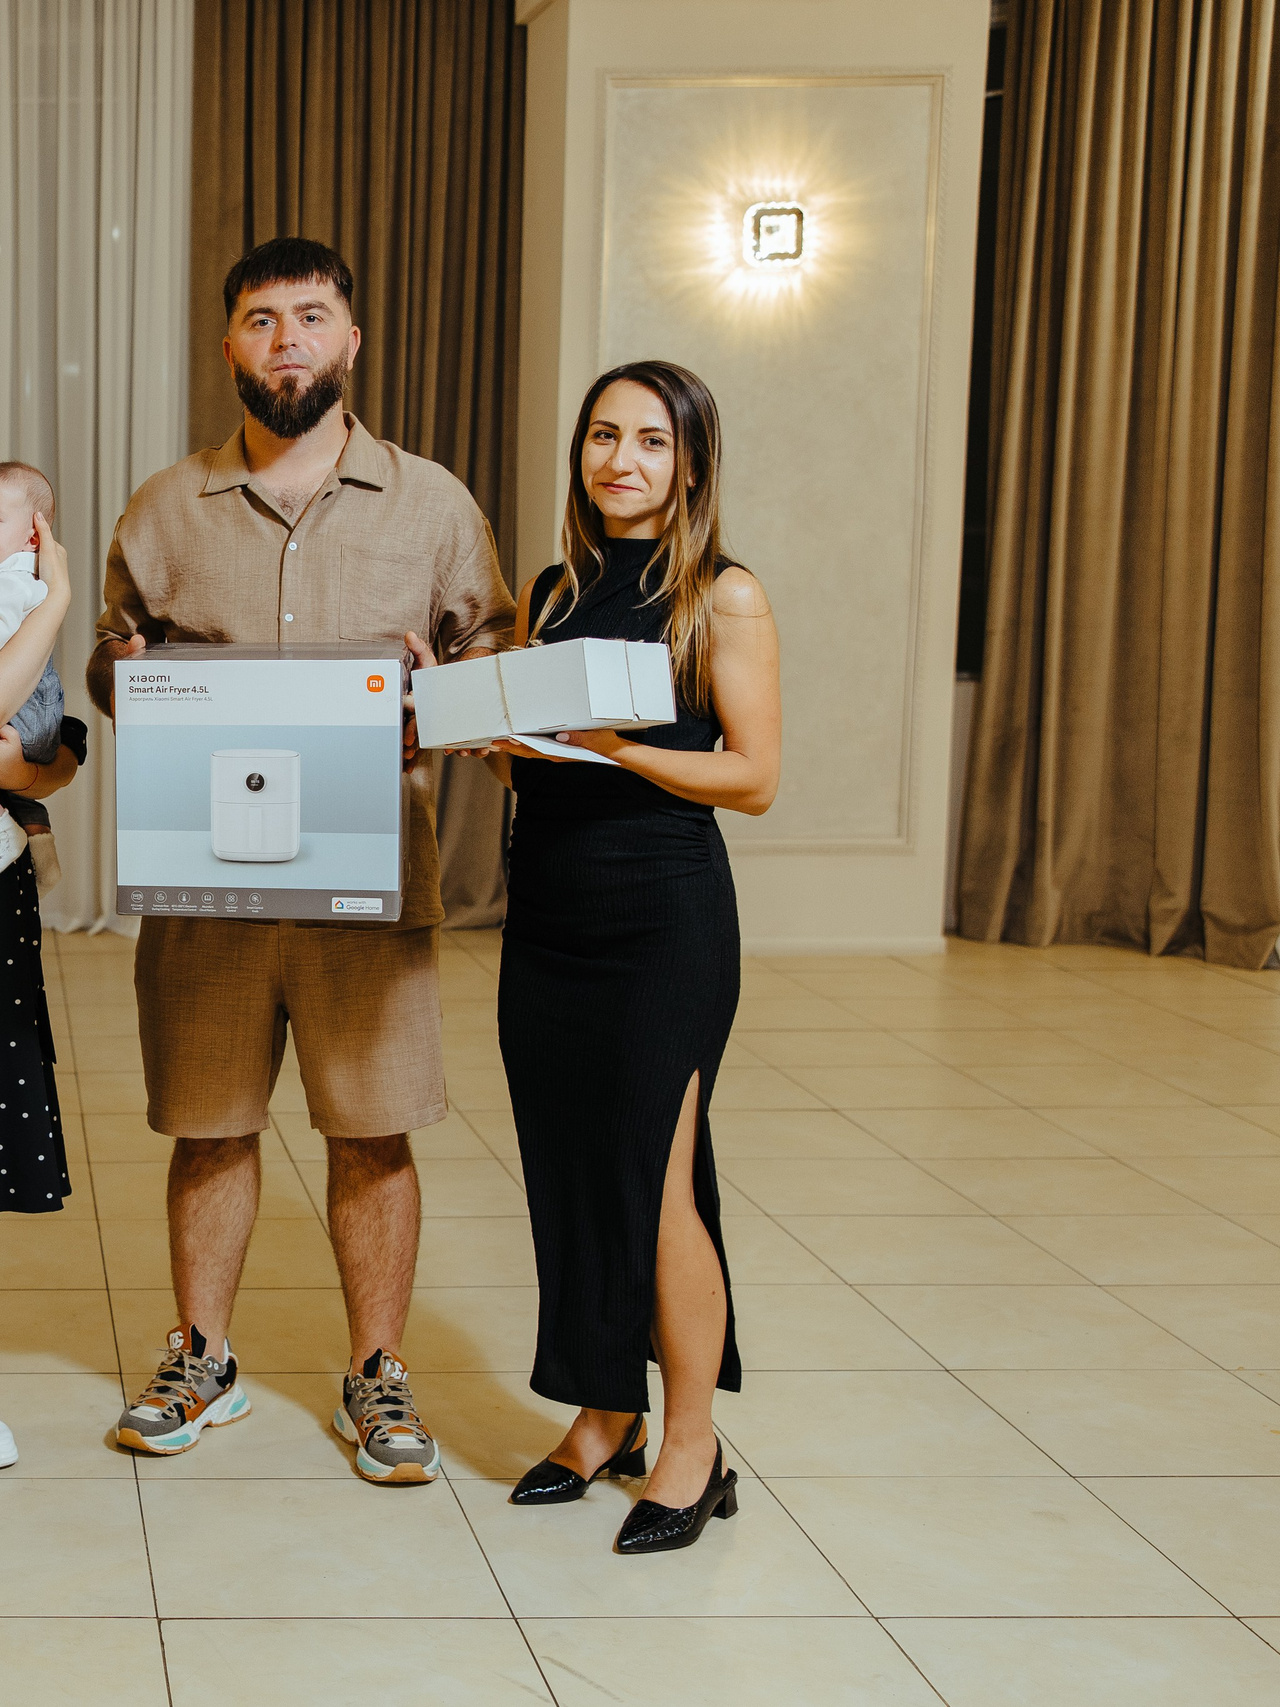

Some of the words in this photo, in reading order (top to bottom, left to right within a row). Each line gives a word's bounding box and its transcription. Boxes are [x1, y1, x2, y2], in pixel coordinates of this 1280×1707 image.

[128, 685, 154, 694] Smart
[155, 685, 168, 694] Air
[169, 685, 191, 696] Fryer
[191, 685, 210, 694] 4.5L
